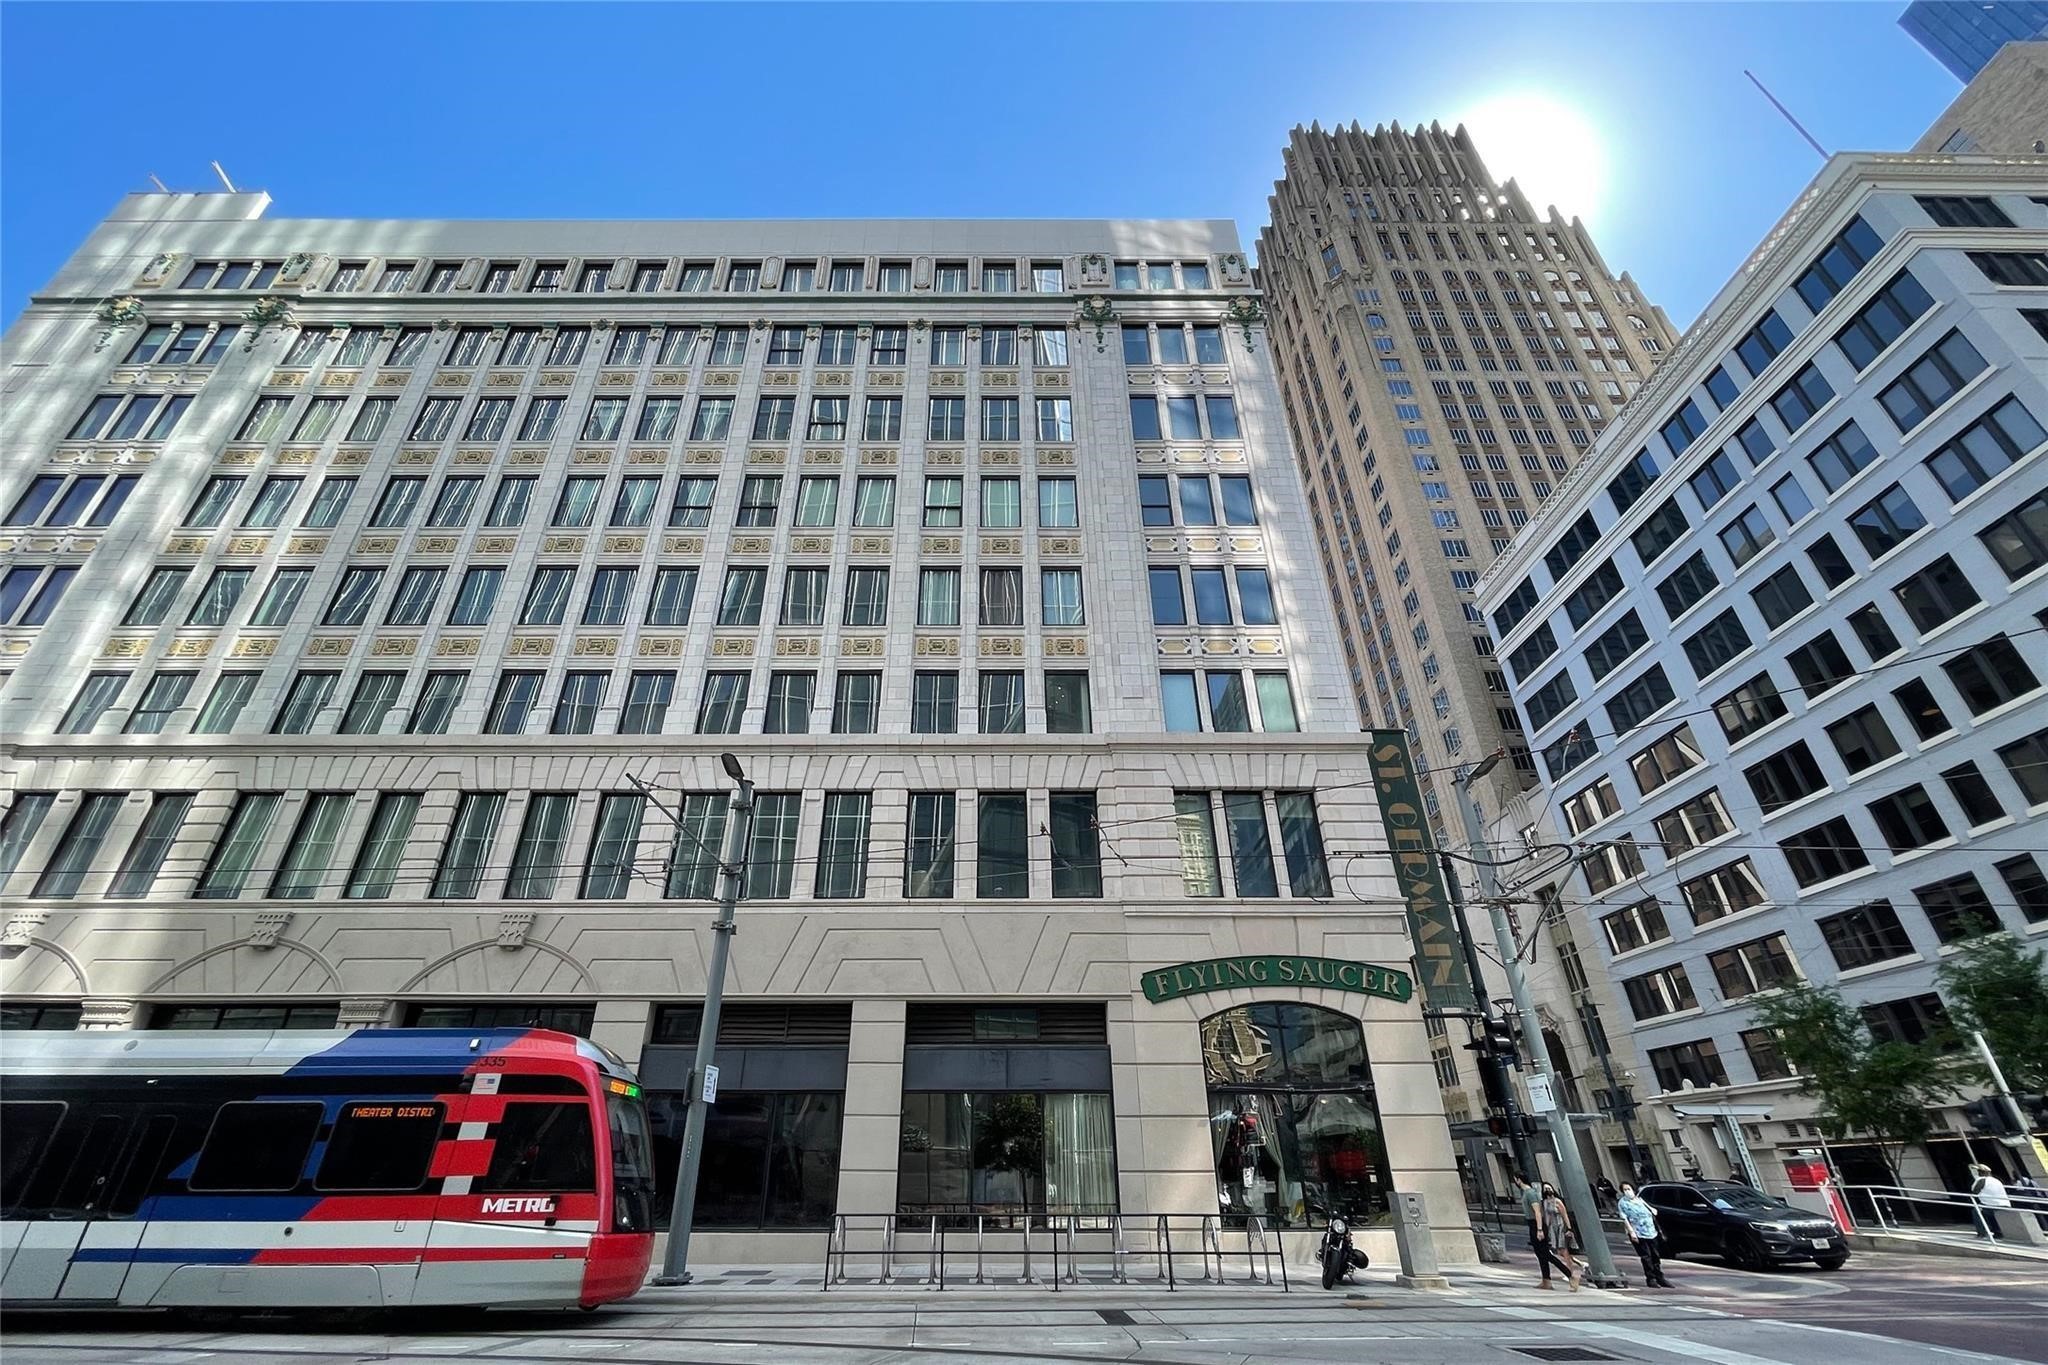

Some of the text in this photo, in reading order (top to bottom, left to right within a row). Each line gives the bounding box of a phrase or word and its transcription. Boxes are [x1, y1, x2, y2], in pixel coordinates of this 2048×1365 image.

[1372, 743, 1460, 987] ST. GERMAIN
[1154, 960, 1401, 996] FLYING SAUCER
[397, 1107, 436, 1117] DISTRI
[481, 1198, 555, 1213] METRO
